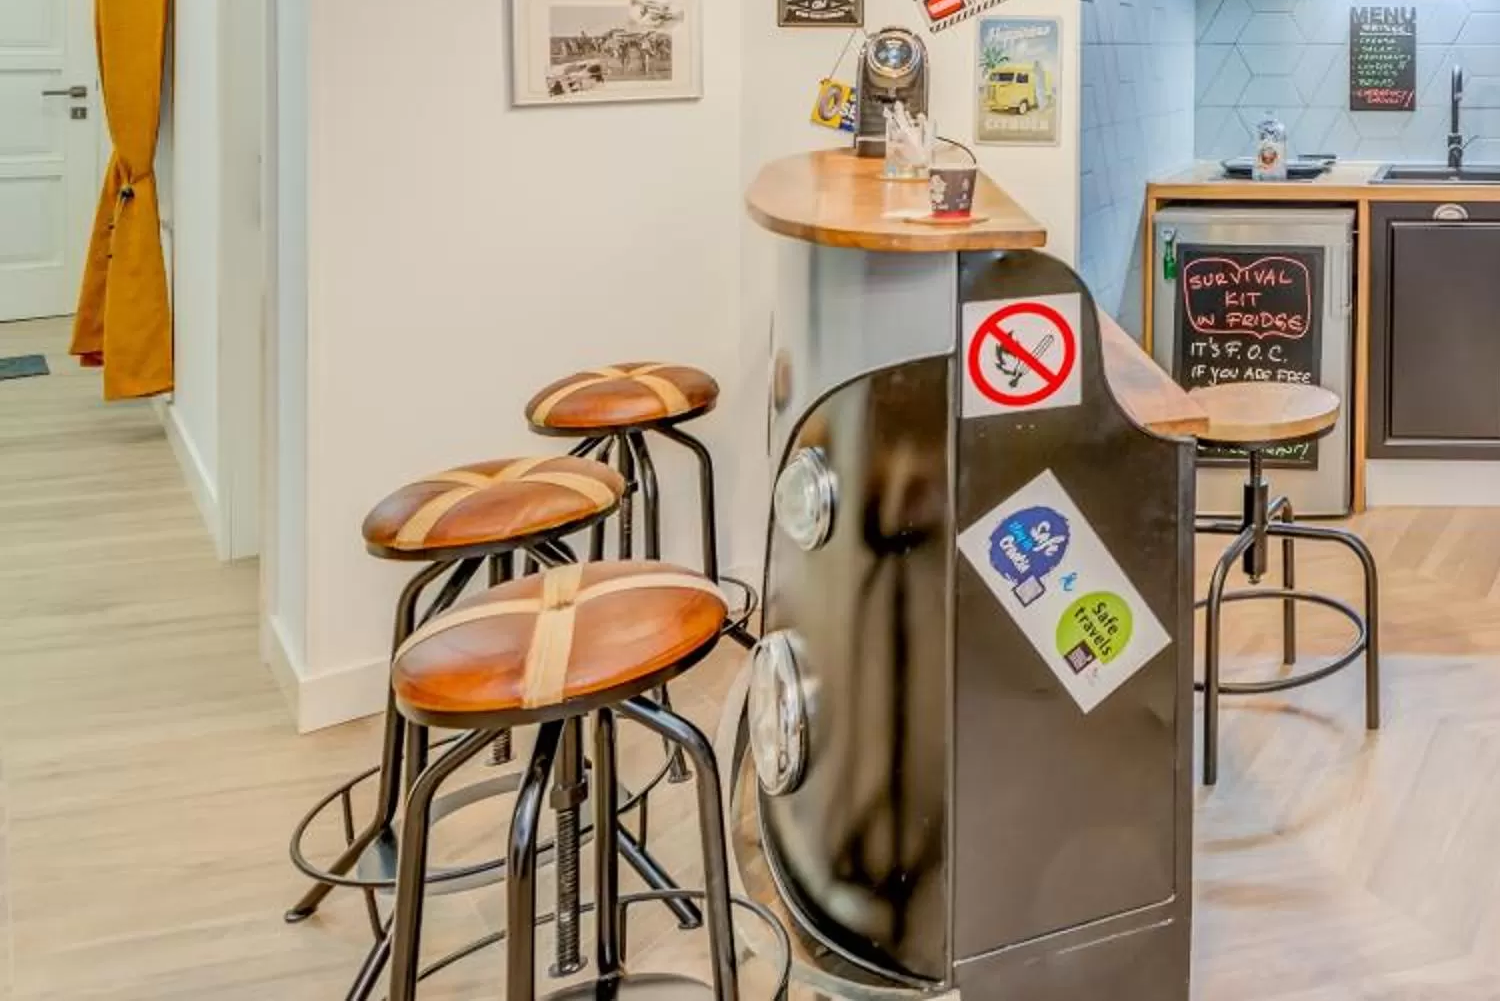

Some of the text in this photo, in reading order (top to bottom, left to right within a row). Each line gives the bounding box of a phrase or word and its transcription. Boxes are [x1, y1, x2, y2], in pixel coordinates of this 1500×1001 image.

[1350, 7, 1416, 24] MENU
[1189, 270, 1293, 290] SURVIVAL
[1225, 291, 1263, 307] KIT
[1226, 311, 1304, 331] FRIDGE
[1191, 364, 1206, 379] IF
[1092, 602, 1119, 636] Safe
[1074, 606, 1112, 656] travels
